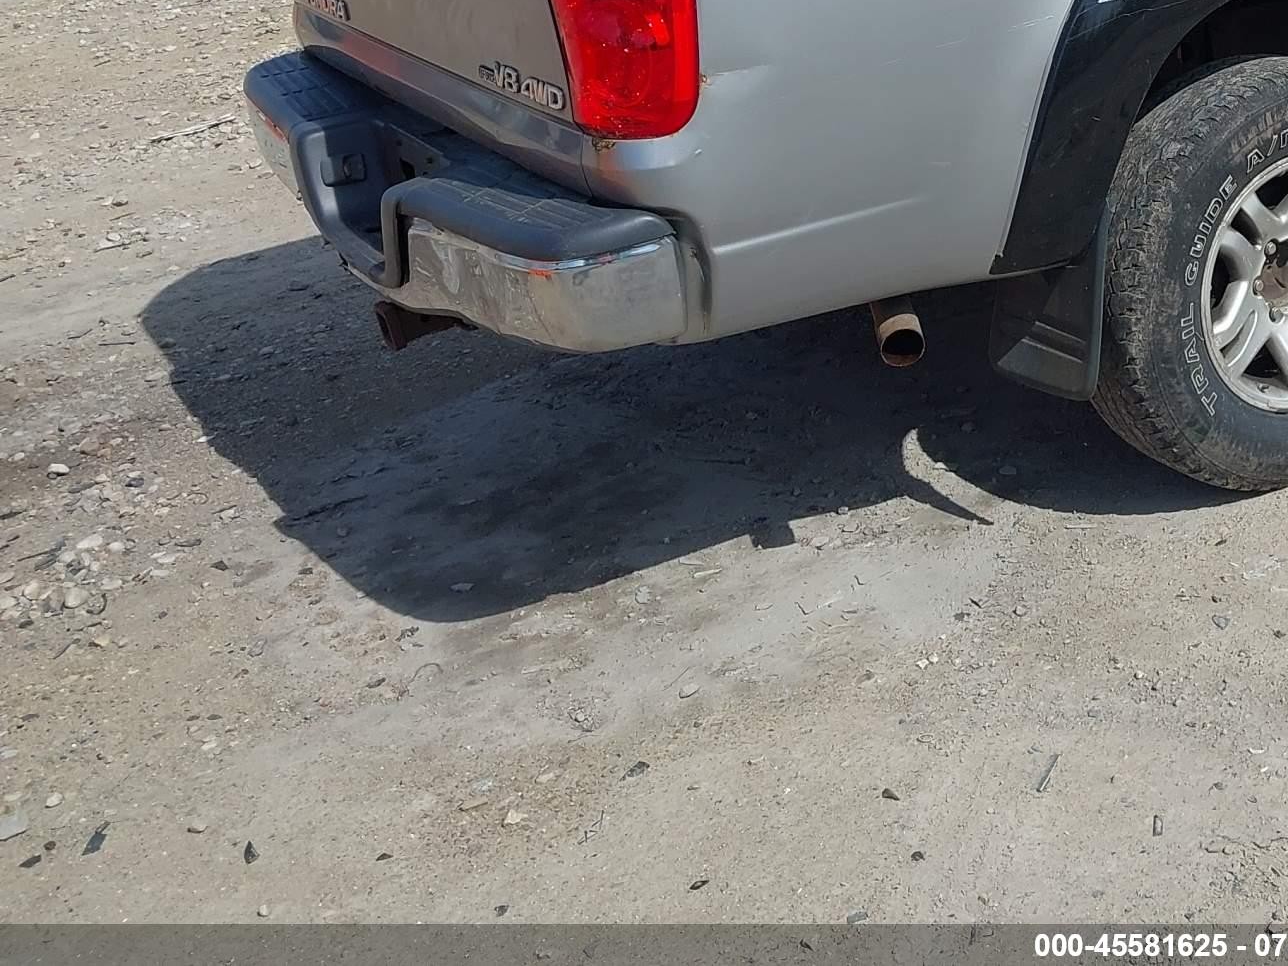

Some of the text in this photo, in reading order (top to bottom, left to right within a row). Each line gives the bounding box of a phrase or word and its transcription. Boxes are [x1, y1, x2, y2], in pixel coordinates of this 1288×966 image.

[494, 63, 519, 93] V8
[521, 77, 565, 111] 4WD
[1185, 175, 1237, 286] GUIDE
[1181, 302, 1217, 416] TRAIL
